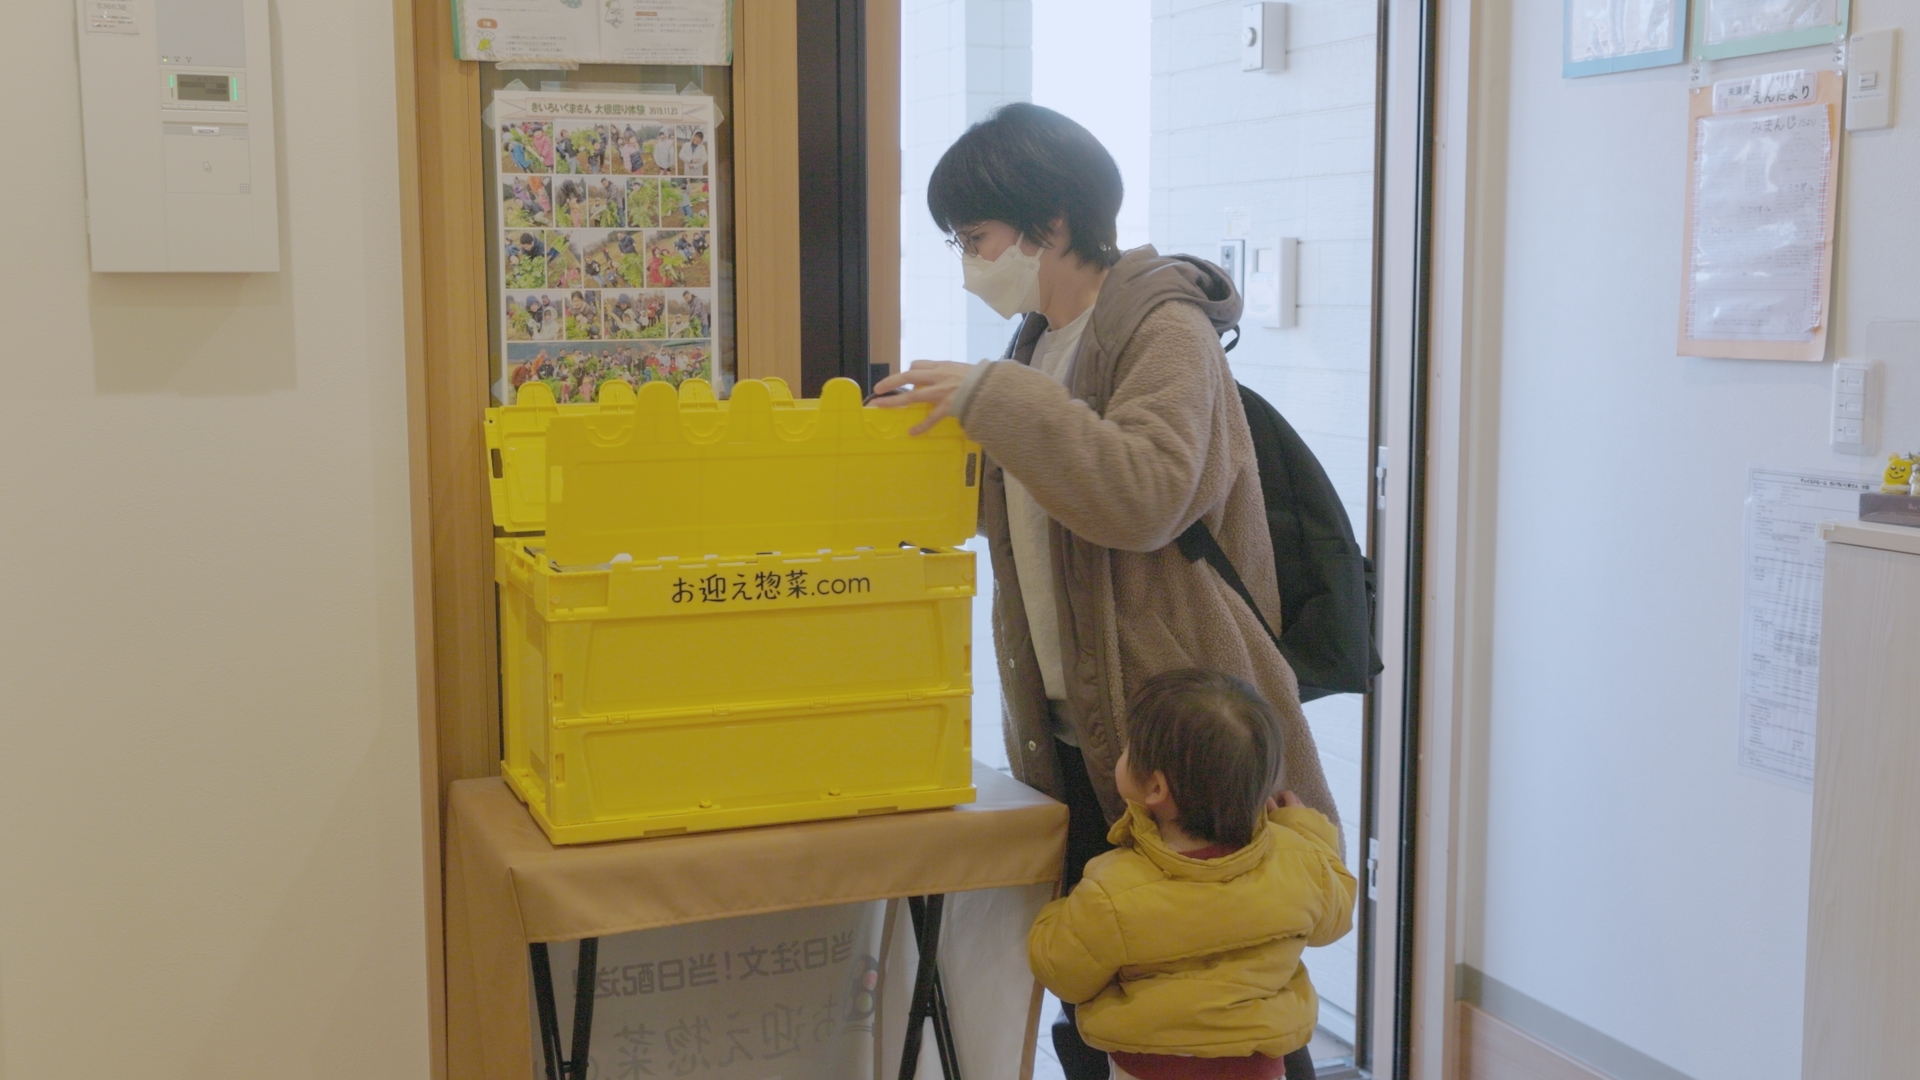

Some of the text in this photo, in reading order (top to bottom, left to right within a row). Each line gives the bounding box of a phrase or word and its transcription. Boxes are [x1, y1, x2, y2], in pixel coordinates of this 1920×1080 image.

[531, 102, 592, 115] きいろいくまさん
[594, 103, 646, 116] 大根掘り体験
[671, 569, 870, 603] お迎え惣菜.com
